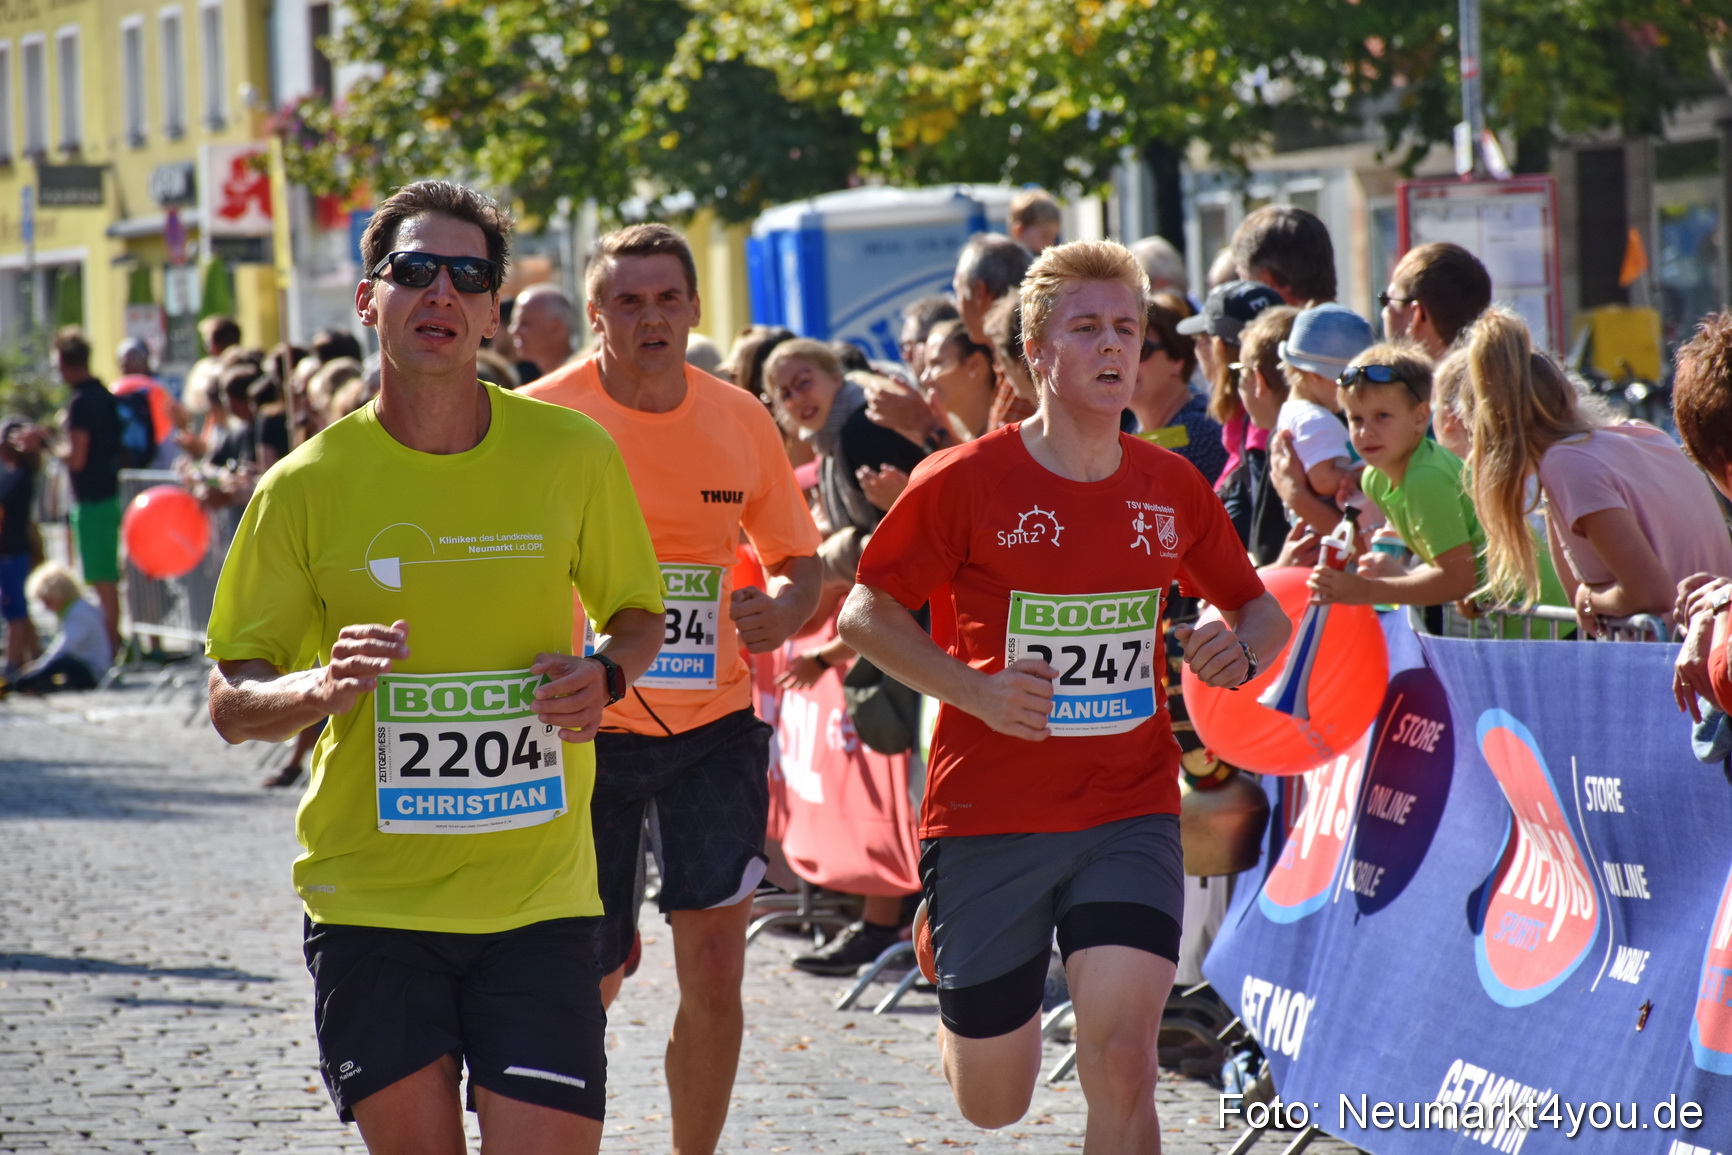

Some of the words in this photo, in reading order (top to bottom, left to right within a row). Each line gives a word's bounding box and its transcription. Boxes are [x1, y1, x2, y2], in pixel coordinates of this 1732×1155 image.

[700, 490, 744, 504] THULE
[1125, 500, 1141, 509] TSV
[439, 536, 477, 544] Kliniken
[479, 534, 495, 542] des
[496, 533, 543, 541] Landkreises
[468, 544, 513, 554] Neumarkt
[997, 530, 1040, 548] Spitz
[661, 570, 711, 597] CK
[663, 608, 704, 645] 34
[1020, 596, 1150, 632] BOCK
[649, 657, 705, 673] STOPH
[389, 676, 545, 717] BOCK
[399, 725, 542, 778] 2204
[1392, 713, 1445, 753] STORE
[396, 786, 547, 815] CHRISTIAN
[1367, 784, 1417, 825] ONLINE
[1584, 775, 1625, 813] STORE
[1345, 859, 1385, 898] MOBILE
[1603, 861, 1651, 900] ONLINE
[1493, 911, 1547, 952] SPORTS
[1608, 945, 1651, 985] MOBILE
[1241, 974, 1274, 1043] GET
